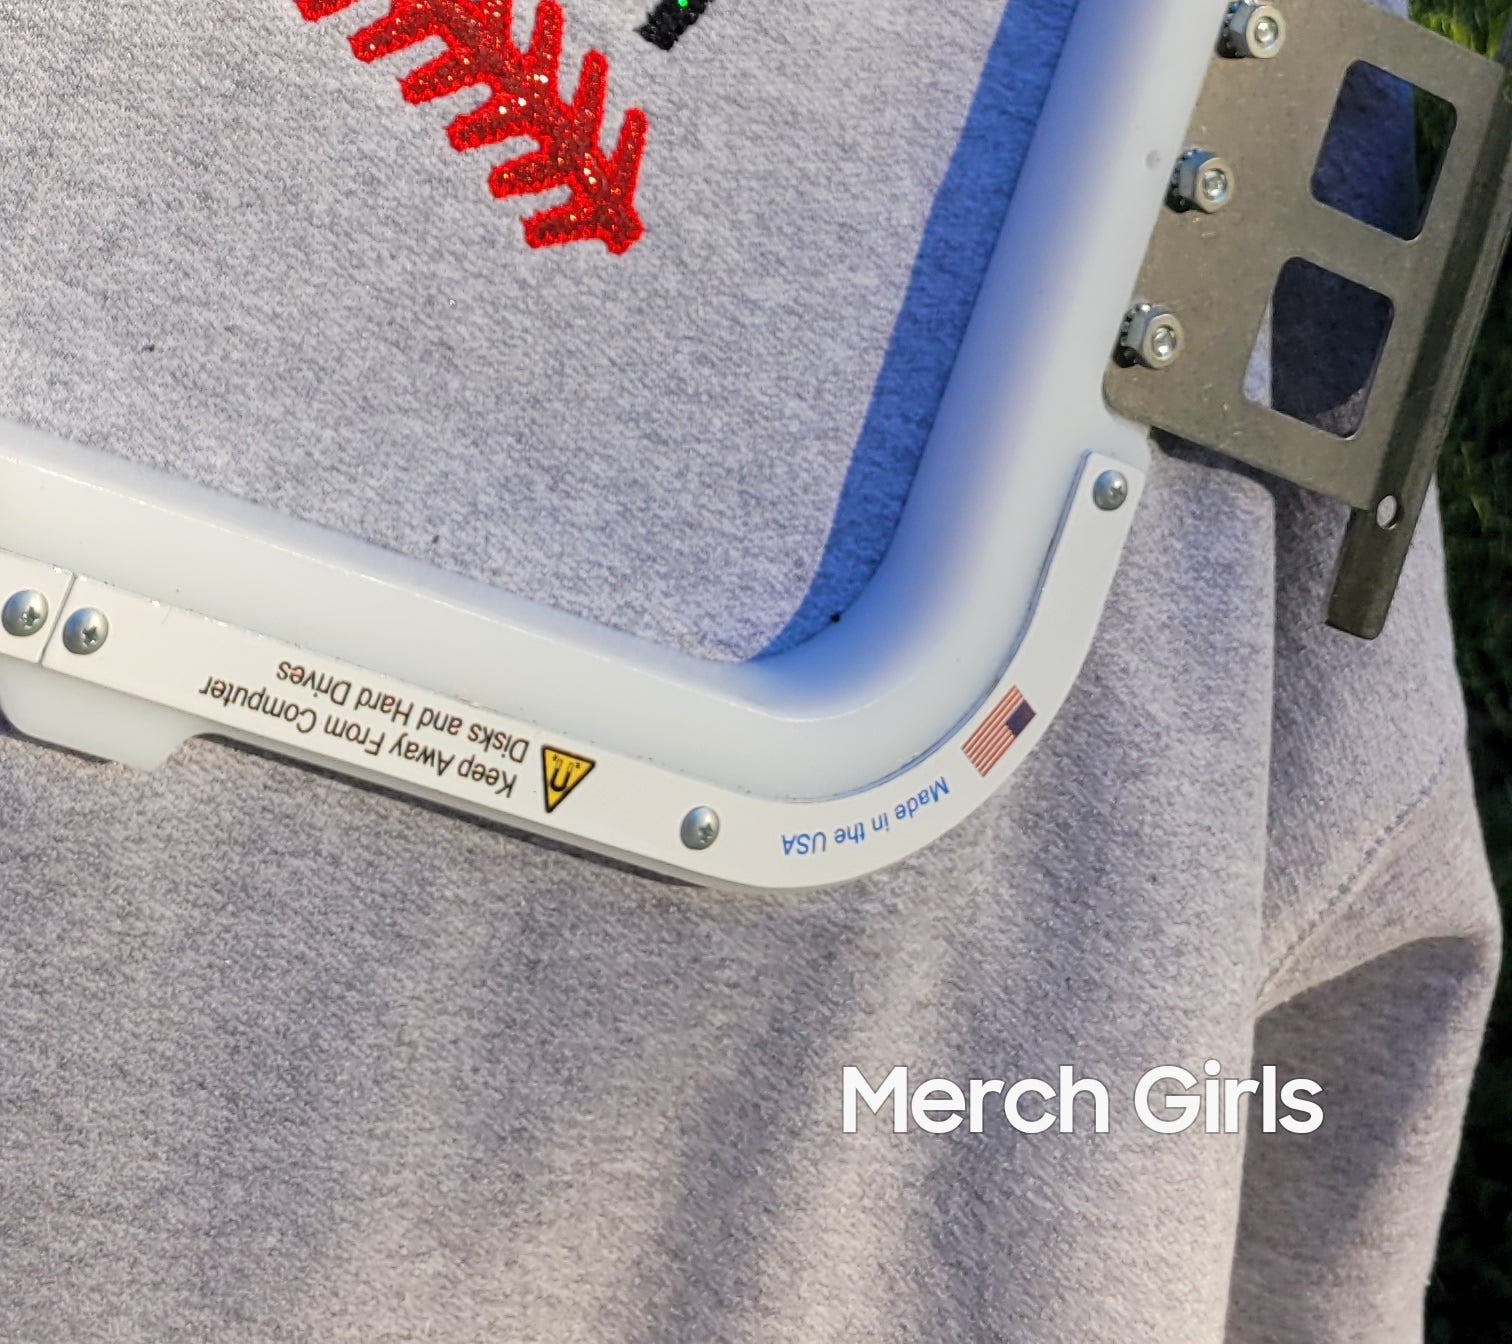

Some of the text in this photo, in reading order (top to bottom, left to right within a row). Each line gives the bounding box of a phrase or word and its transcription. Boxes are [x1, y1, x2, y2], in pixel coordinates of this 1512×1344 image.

[198, 674, 518, 799] Keep Away From Computer
[276, 660, 529, 764] Disks and Hard Drives
[781, 776, 950, 856] Made in the USA
